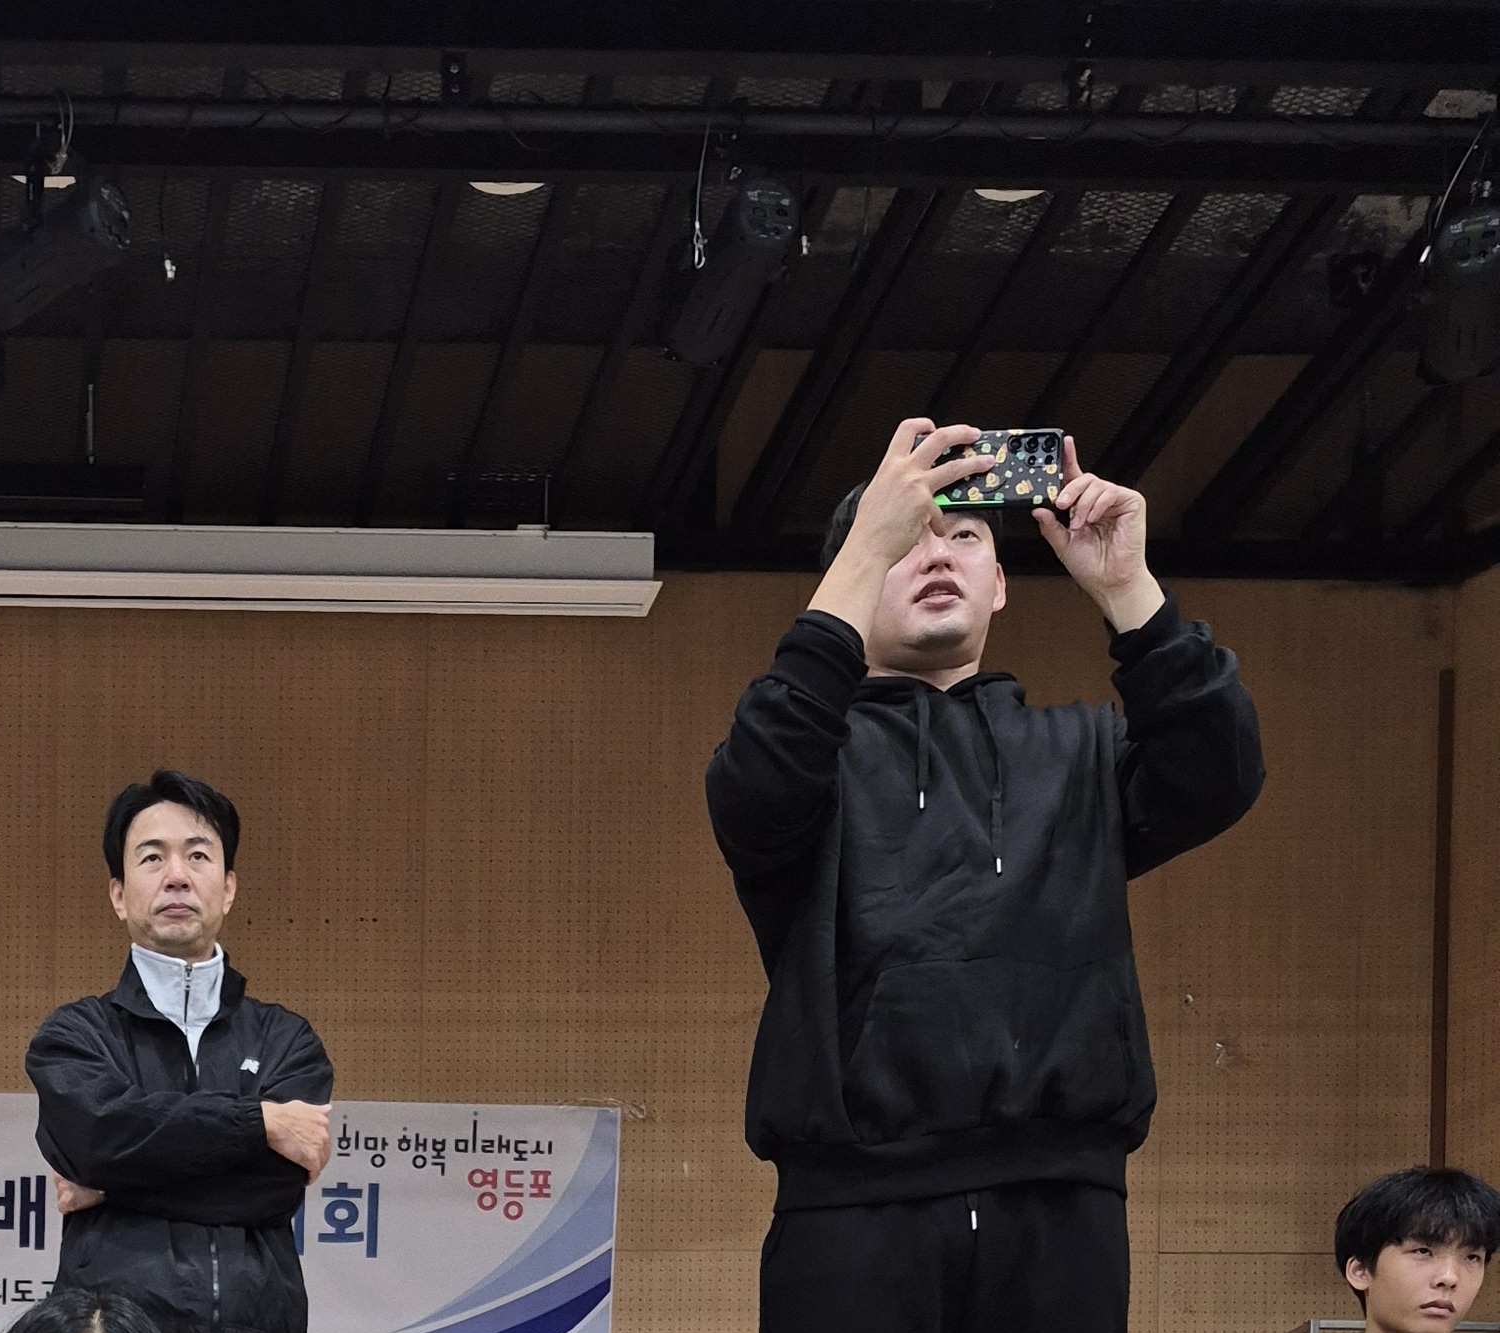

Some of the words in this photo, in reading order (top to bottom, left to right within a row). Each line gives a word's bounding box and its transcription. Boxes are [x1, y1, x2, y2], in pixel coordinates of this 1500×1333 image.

[337, 1115, 389, 1168] 희망
[398, 1127, 446, 1176] 행복
[455, 1111, 552, 1162] 미래도시
[294, 1181, 379, 1258] 회
[467, 1168, 551, 1220] 영등포
